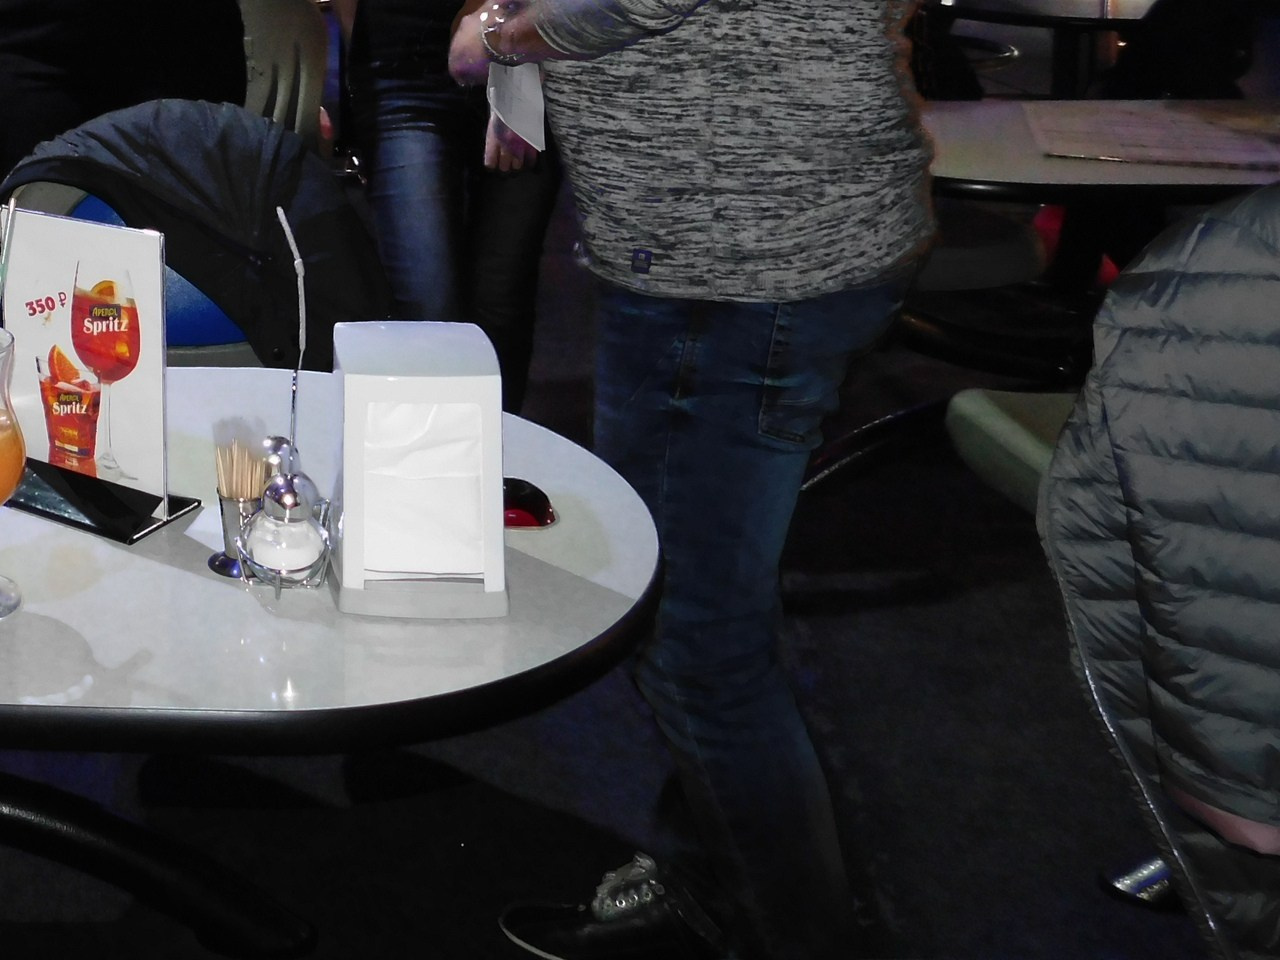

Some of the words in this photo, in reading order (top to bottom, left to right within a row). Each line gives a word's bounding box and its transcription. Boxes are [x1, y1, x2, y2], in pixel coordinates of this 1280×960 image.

[25, 296, 56, 317] 350
[92, 306, 118, 317] APEROL
[83, 316, 128, 336] Spritz
[52, 401, 88, 417] Spritz
